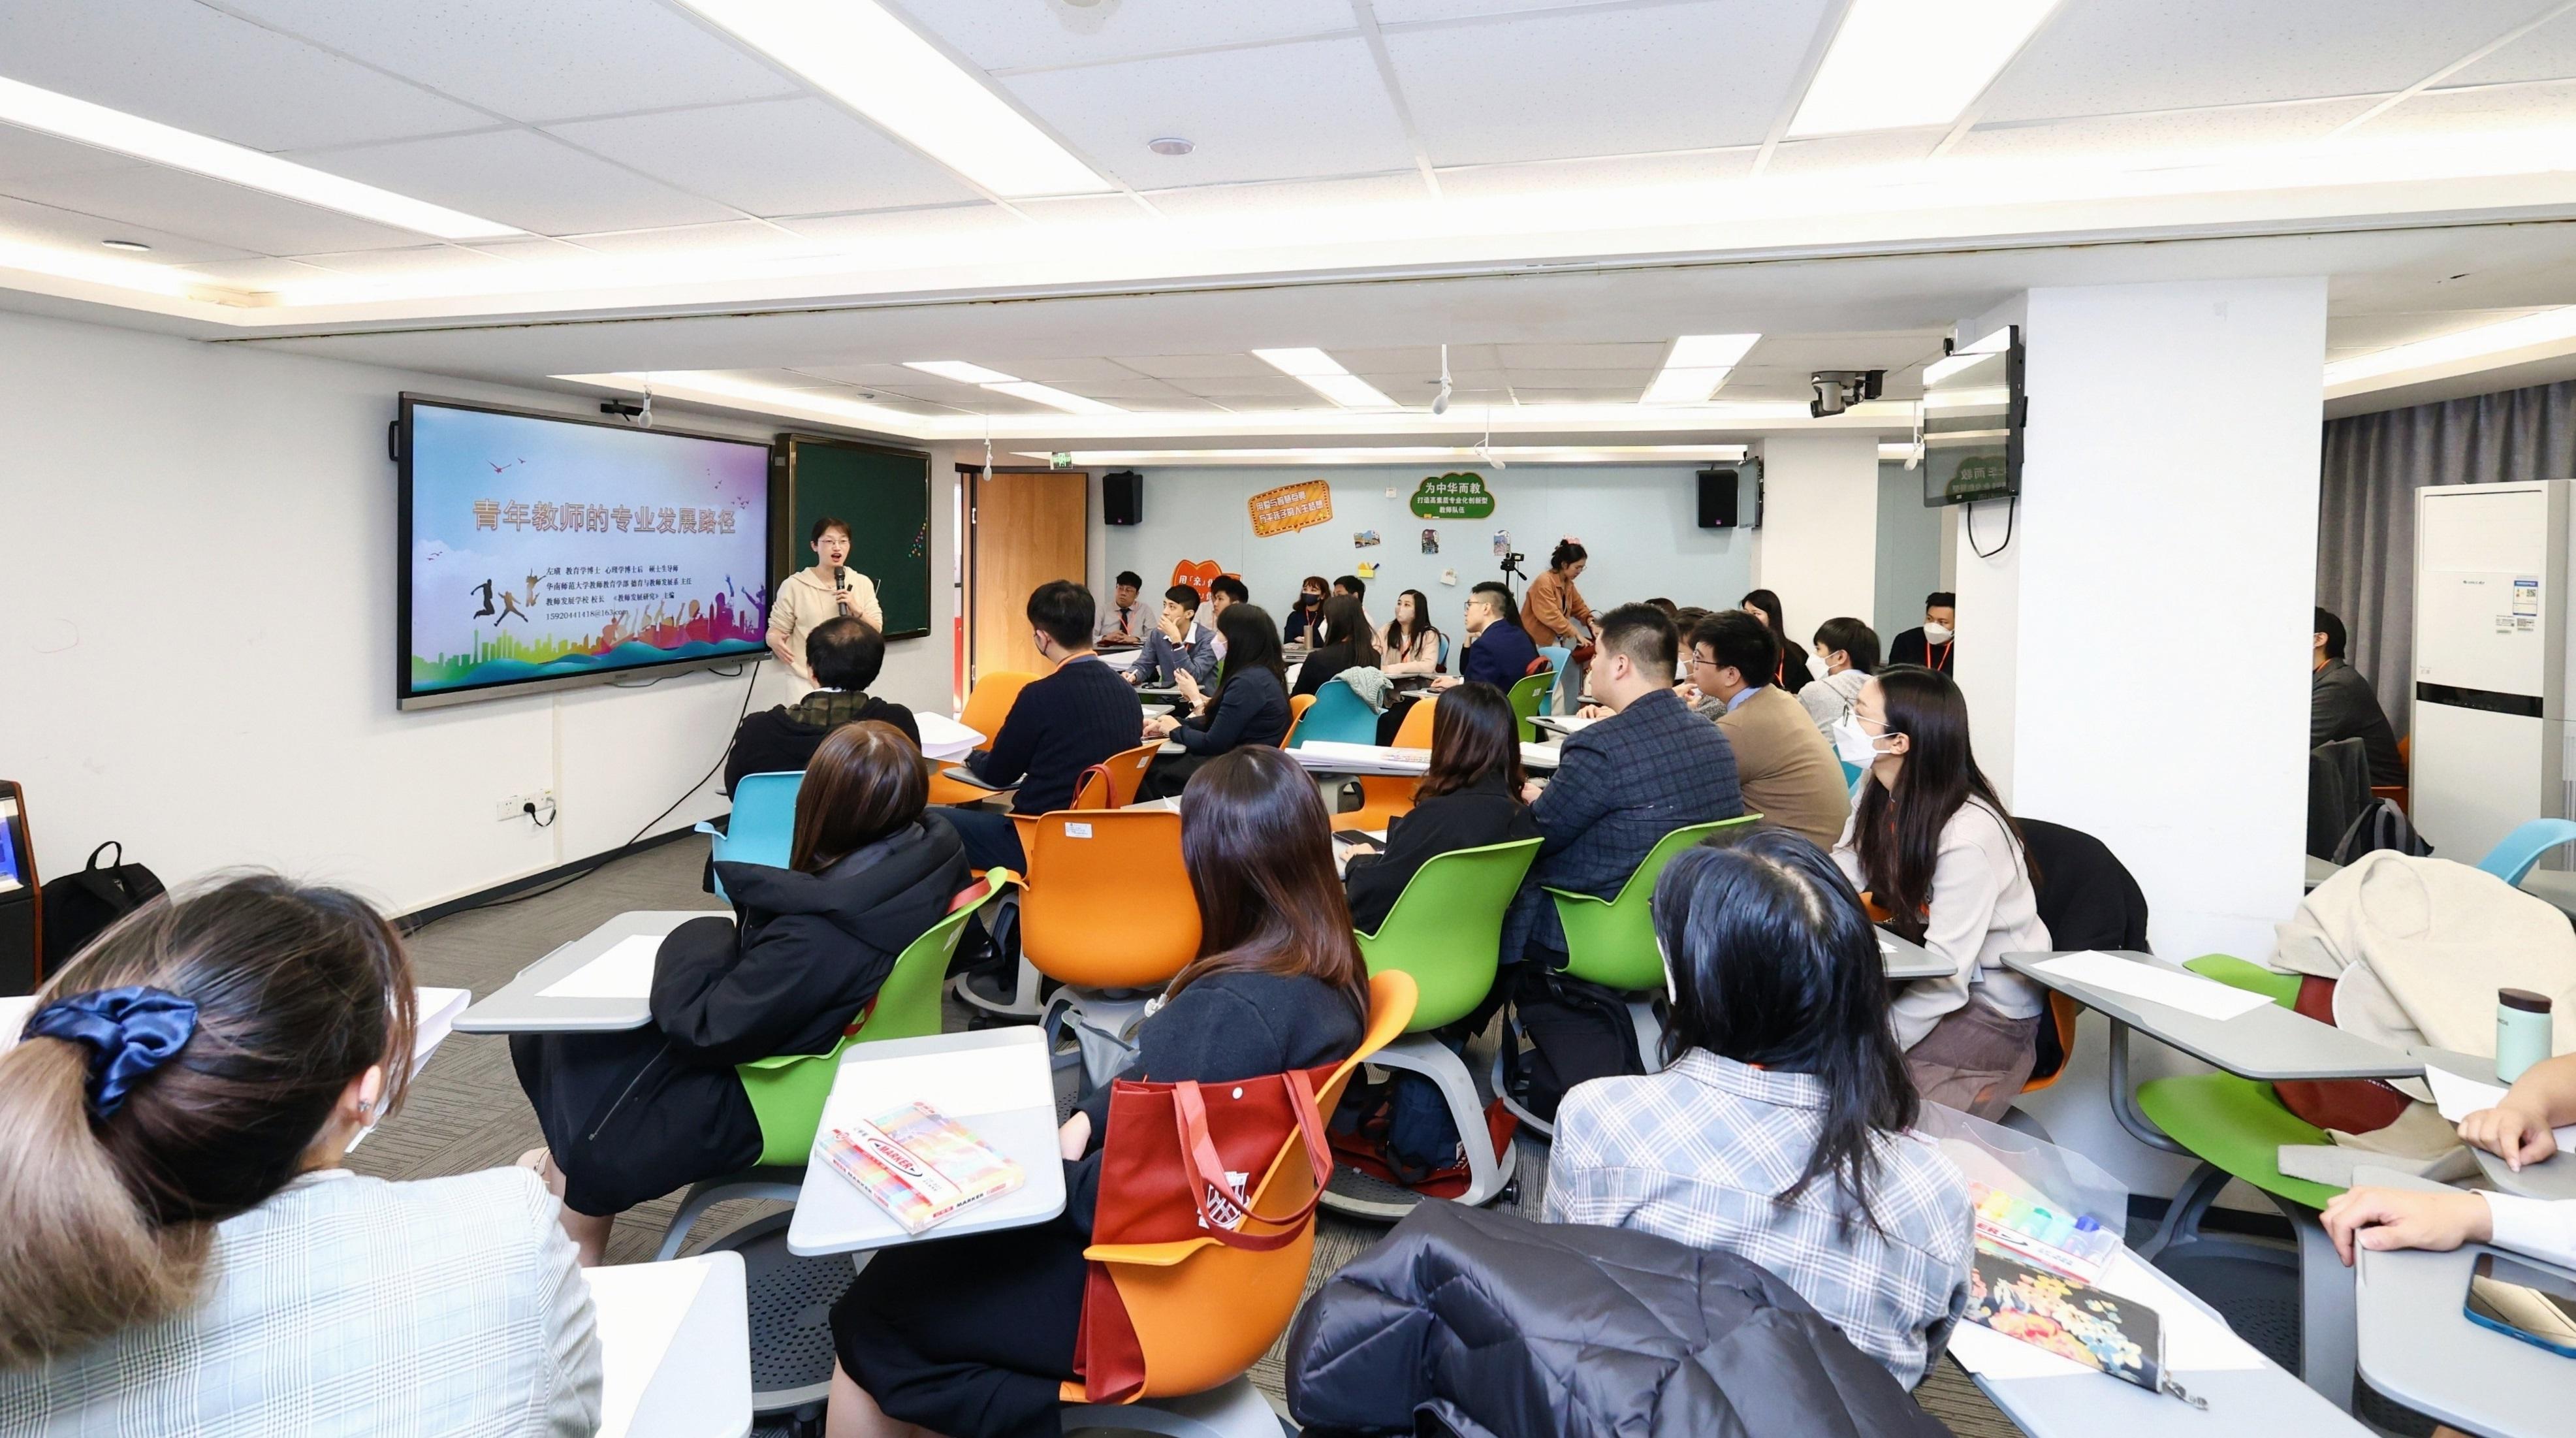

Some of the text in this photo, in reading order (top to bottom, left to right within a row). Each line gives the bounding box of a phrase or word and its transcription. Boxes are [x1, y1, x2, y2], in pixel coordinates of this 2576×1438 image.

[1425, 483, 1481, 494] 为中华而教
[473, 498, 736, 534] 青年教师的专业发展路径
[565, 566, 601, 575] 教育学博士
[605, 566, 643, 575] 心理学博士后
[649, 565, 679, 573] 硕士生导师
[546, 580, 629, 591] 华南师范大学教师教育学部
[631, 578, 679, 587] 德育与教师发展系
[546, 596, 589, 606] 教师发展学校
[591, 596, 605, 604] 校长
[613, 593, 660, 602] 《教师发展研究》
[878, 1145, 914, 1170] MARKER
[848, 1172, 872, 1193] MARKER
[956, 1193, 984, 1207] MARKER
